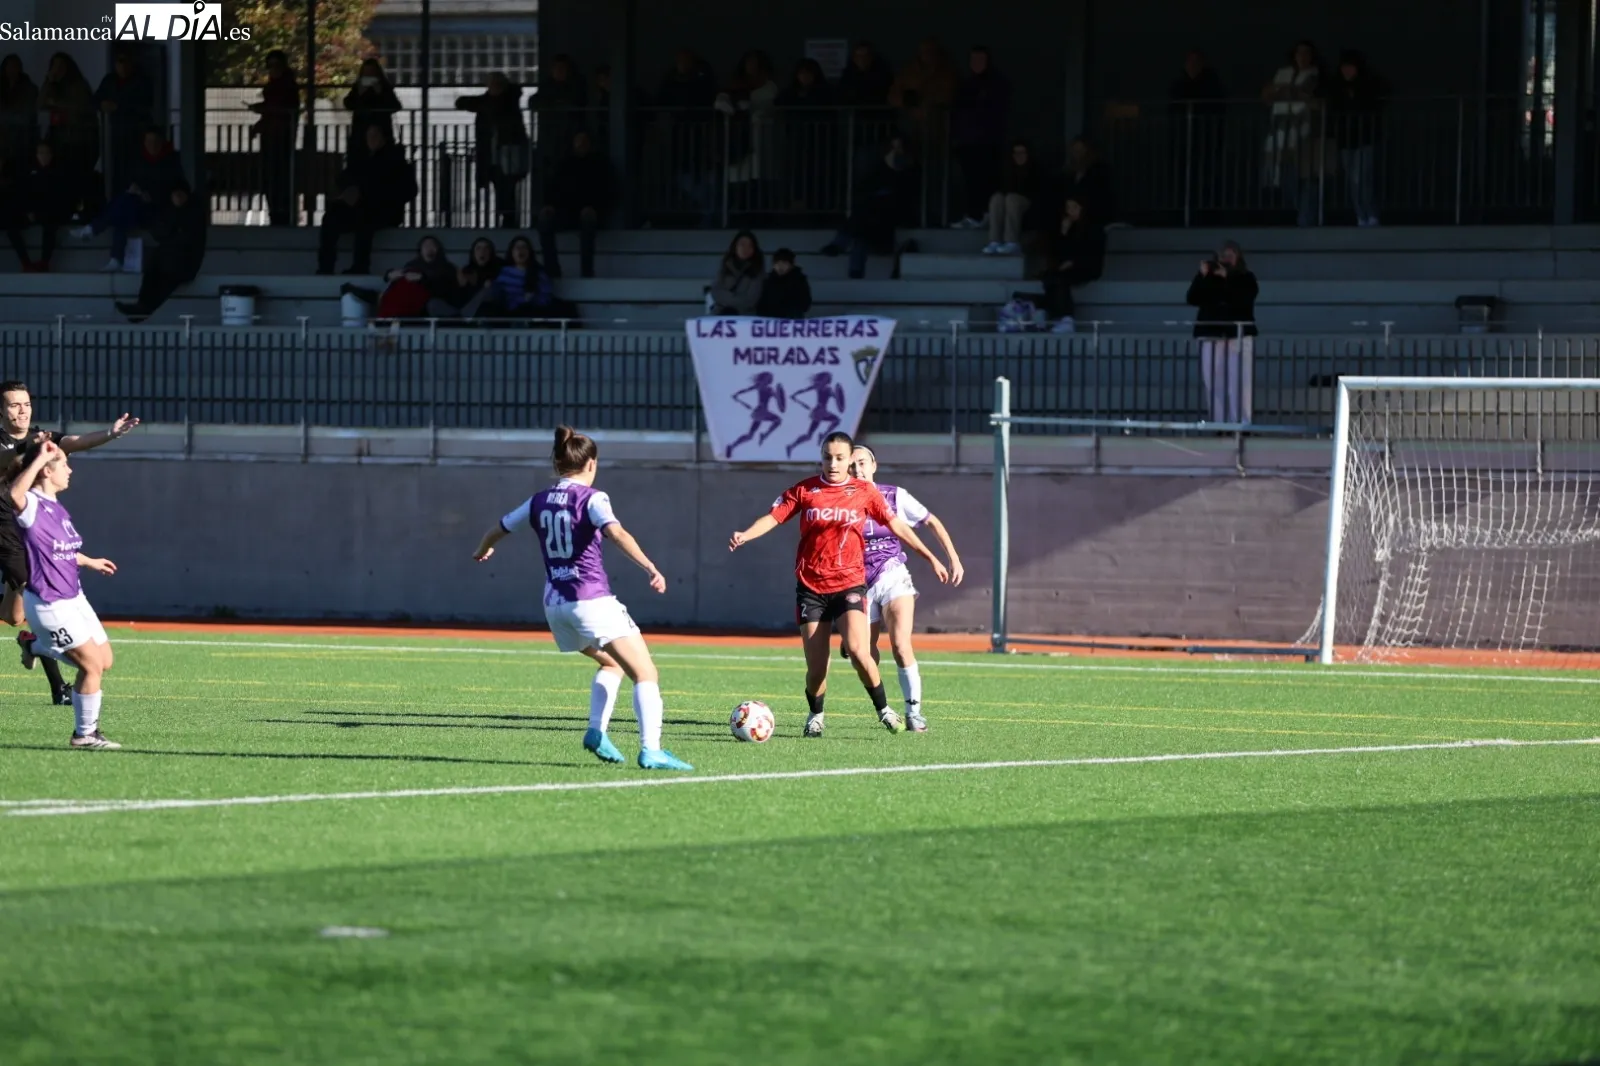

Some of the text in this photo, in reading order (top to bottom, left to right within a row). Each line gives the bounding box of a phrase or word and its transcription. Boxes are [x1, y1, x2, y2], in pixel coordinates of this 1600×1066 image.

[696, 319, 880, 338] LAS GUERRERAS
[733, 346, 840, 366] MORADAS
[806, 506, 859, 523] meins
[540, 509, 573, 559] 20
[51, 627, 74, 649] 23
